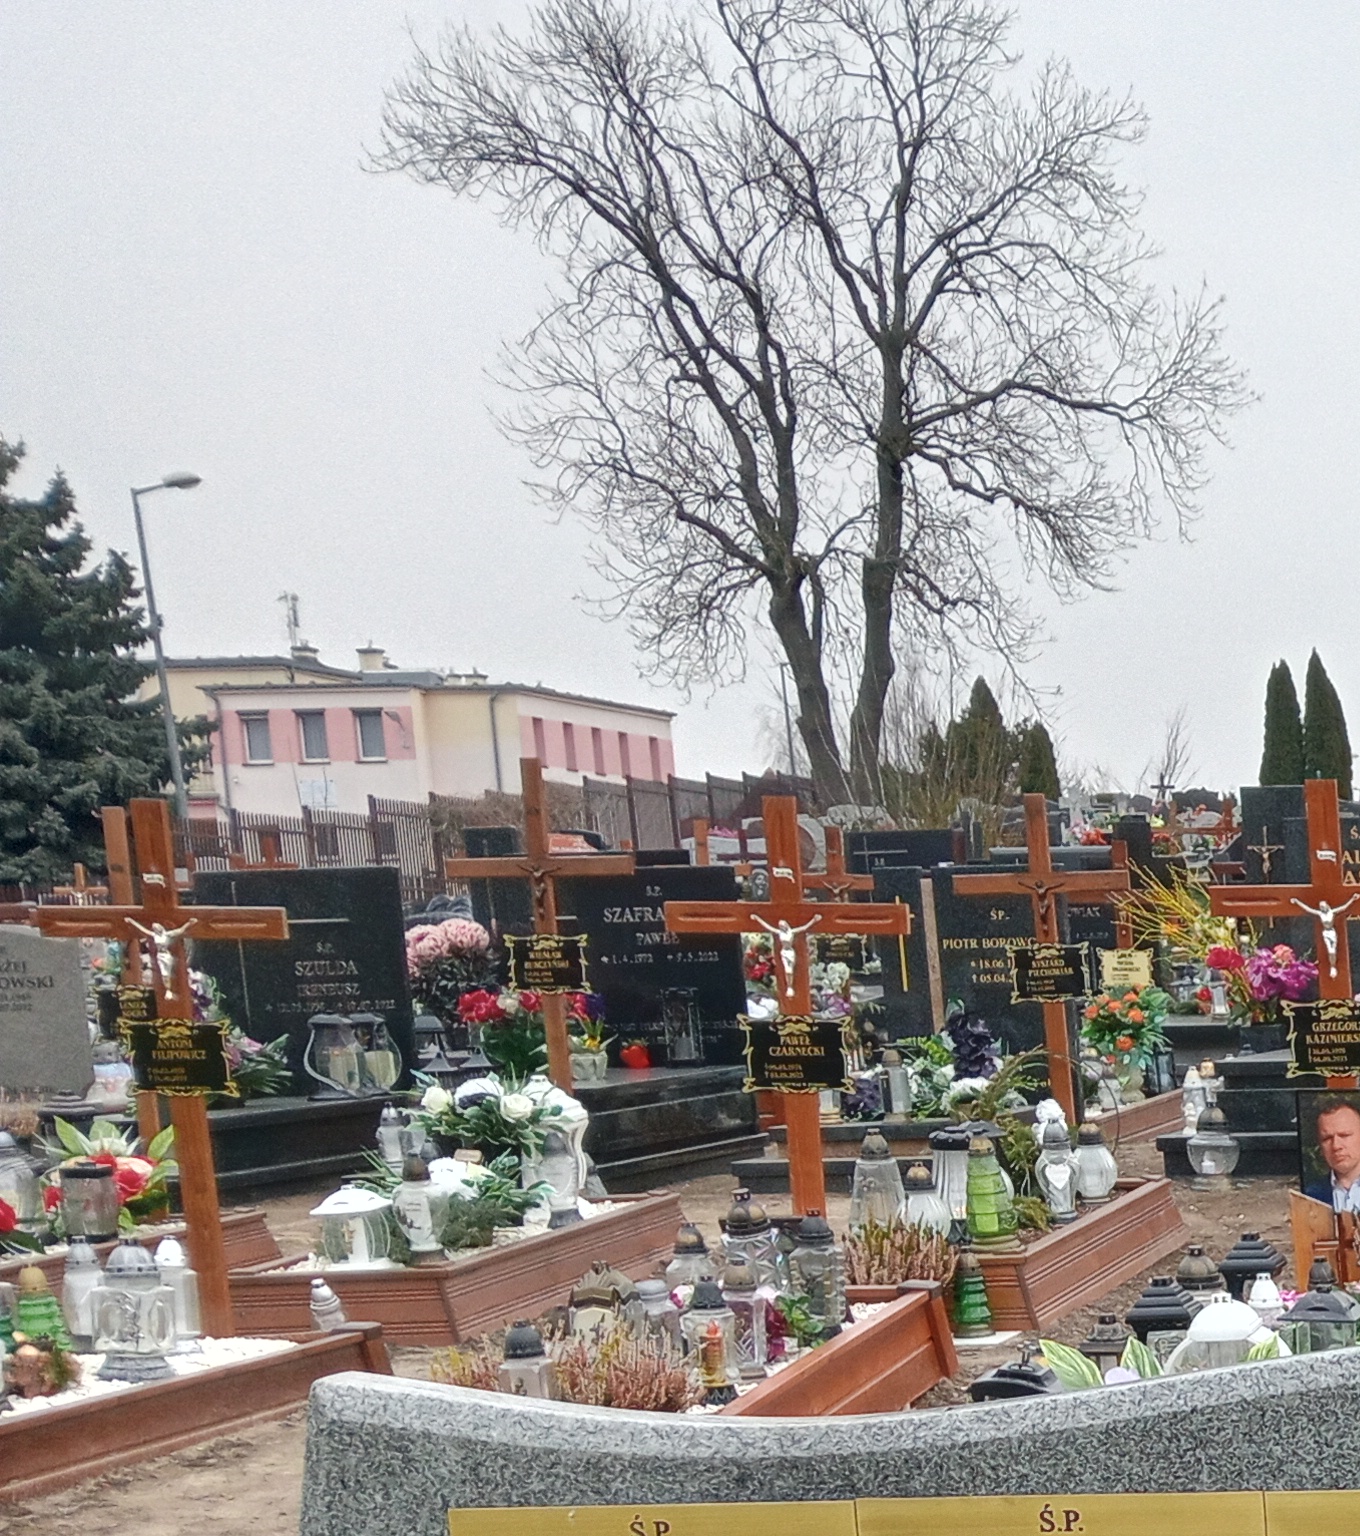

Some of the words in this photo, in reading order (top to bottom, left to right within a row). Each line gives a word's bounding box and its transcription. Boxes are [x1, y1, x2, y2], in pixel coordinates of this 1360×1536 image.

[603, 907, 666, 924] SZAFRA
[294, 960, 359, 977] SZULDA
[0, 975, 55, 991] OWSKI
[1039, 1503, 1084, 1533] Ś.P.
